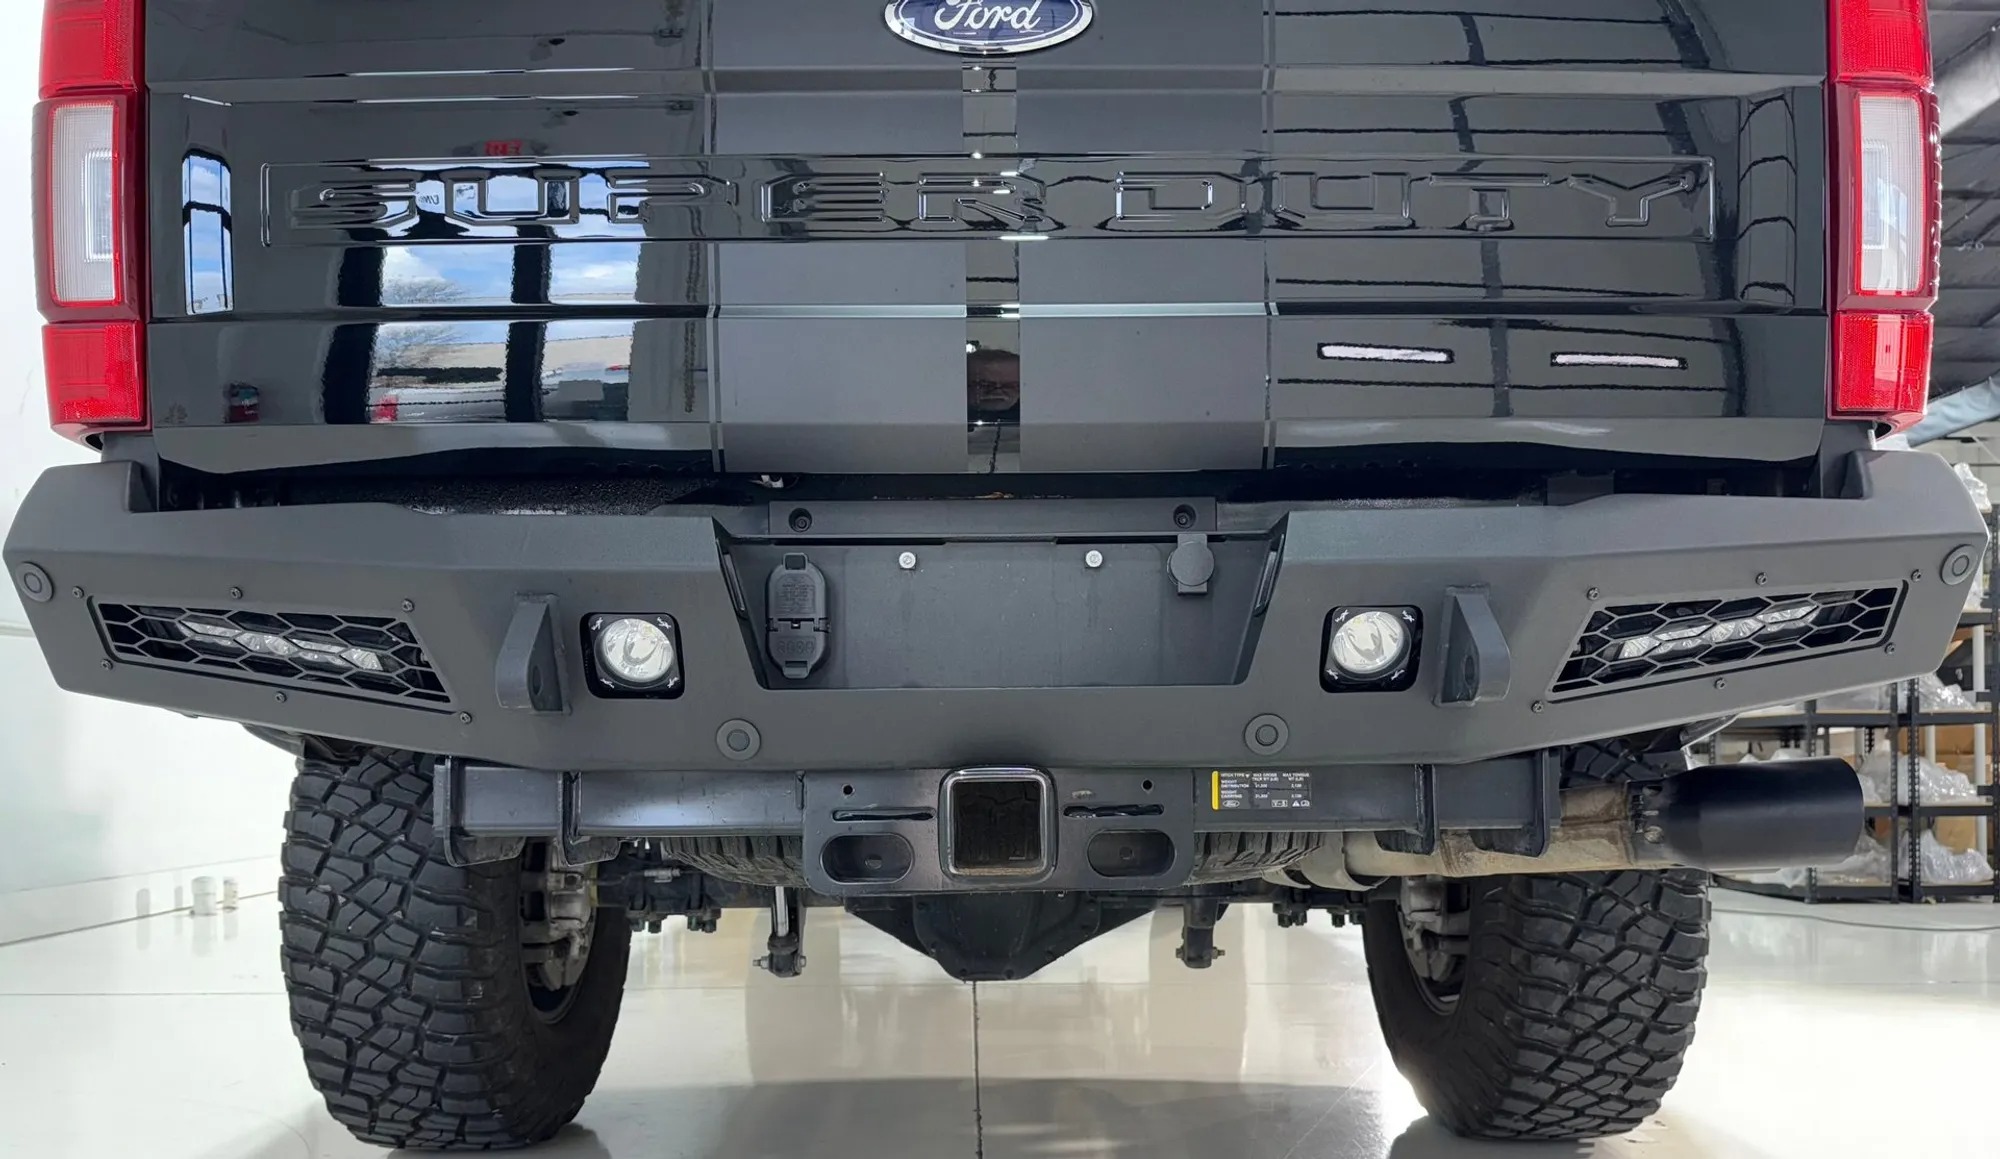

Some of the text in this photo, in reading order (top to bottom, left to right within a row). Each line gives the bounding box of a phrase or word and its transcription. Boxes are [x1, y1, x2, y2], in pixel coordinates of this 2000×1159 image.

[934, 0, 1042, 30] Ford
[287, 170, 1695, 229] SUPER DUTY
